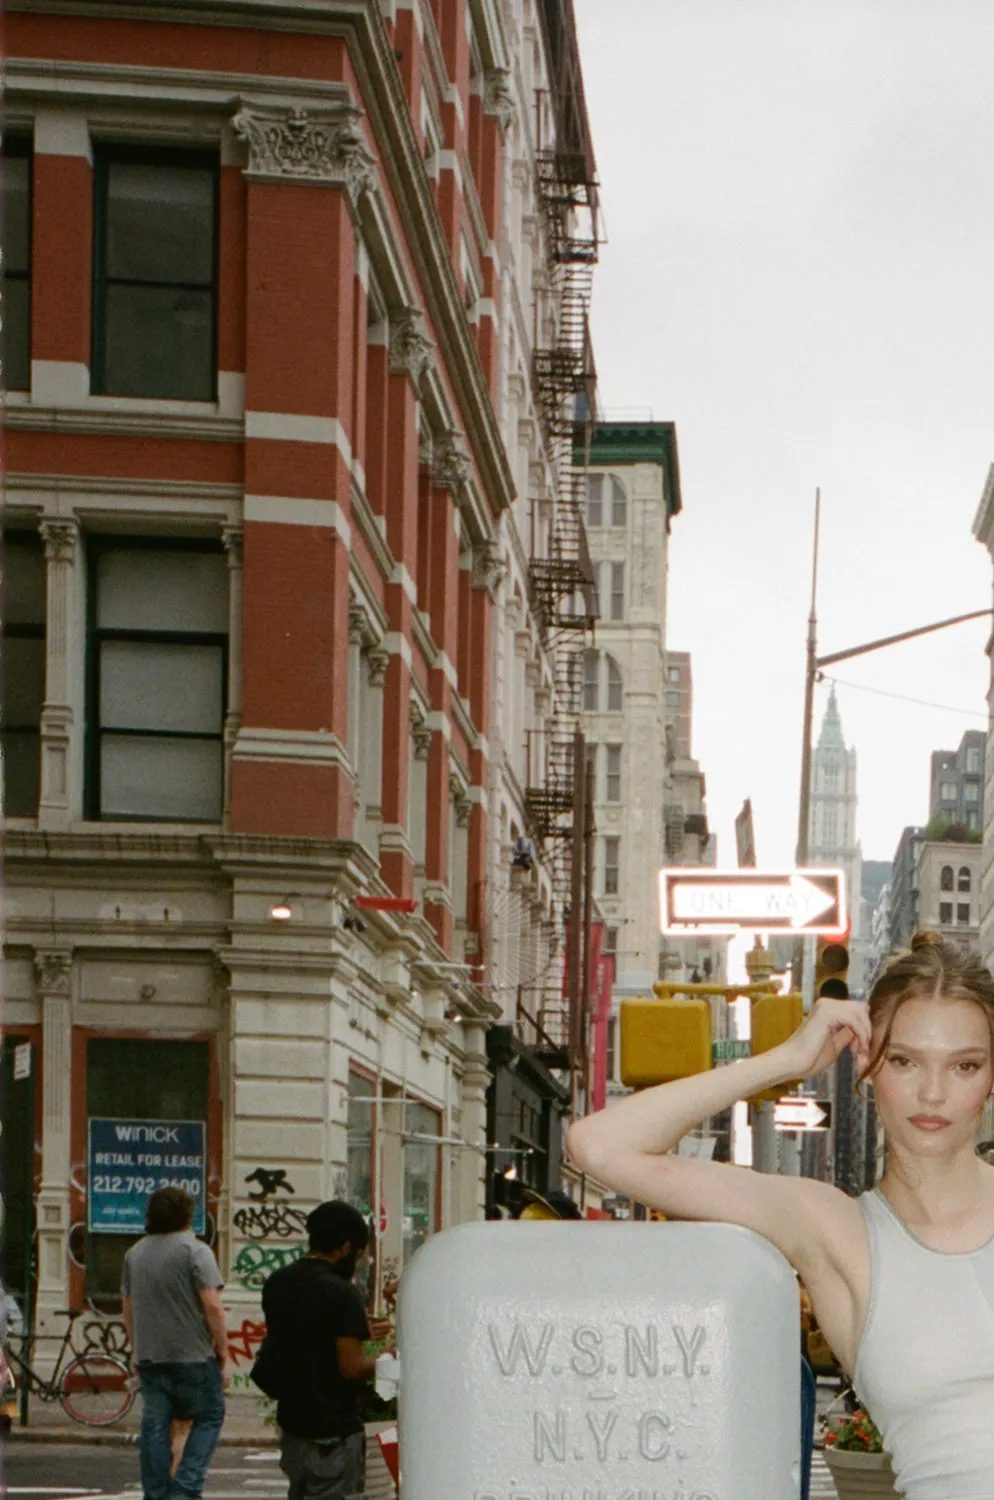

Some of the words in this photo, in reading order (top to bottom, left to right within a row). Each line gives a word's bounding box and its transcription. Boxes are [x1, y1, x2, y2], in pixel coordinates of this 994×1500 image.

[690, 890, 738, 912] ONE
[765, 891, 813, 912] WAY
[717, 1041, 751, 1060] HOWA
[95, 1152, 135, 1166] RETAIL
[137, 1154, 161, 1167] FOR
[164, 1155, 203, 1168] LEASE
[93, 1176, 200, 1196] 212.7922600
[488, 1323, 711, 1378] W.S.N.Y.
[532, 1410, 688, 1462] N.Y.C.
